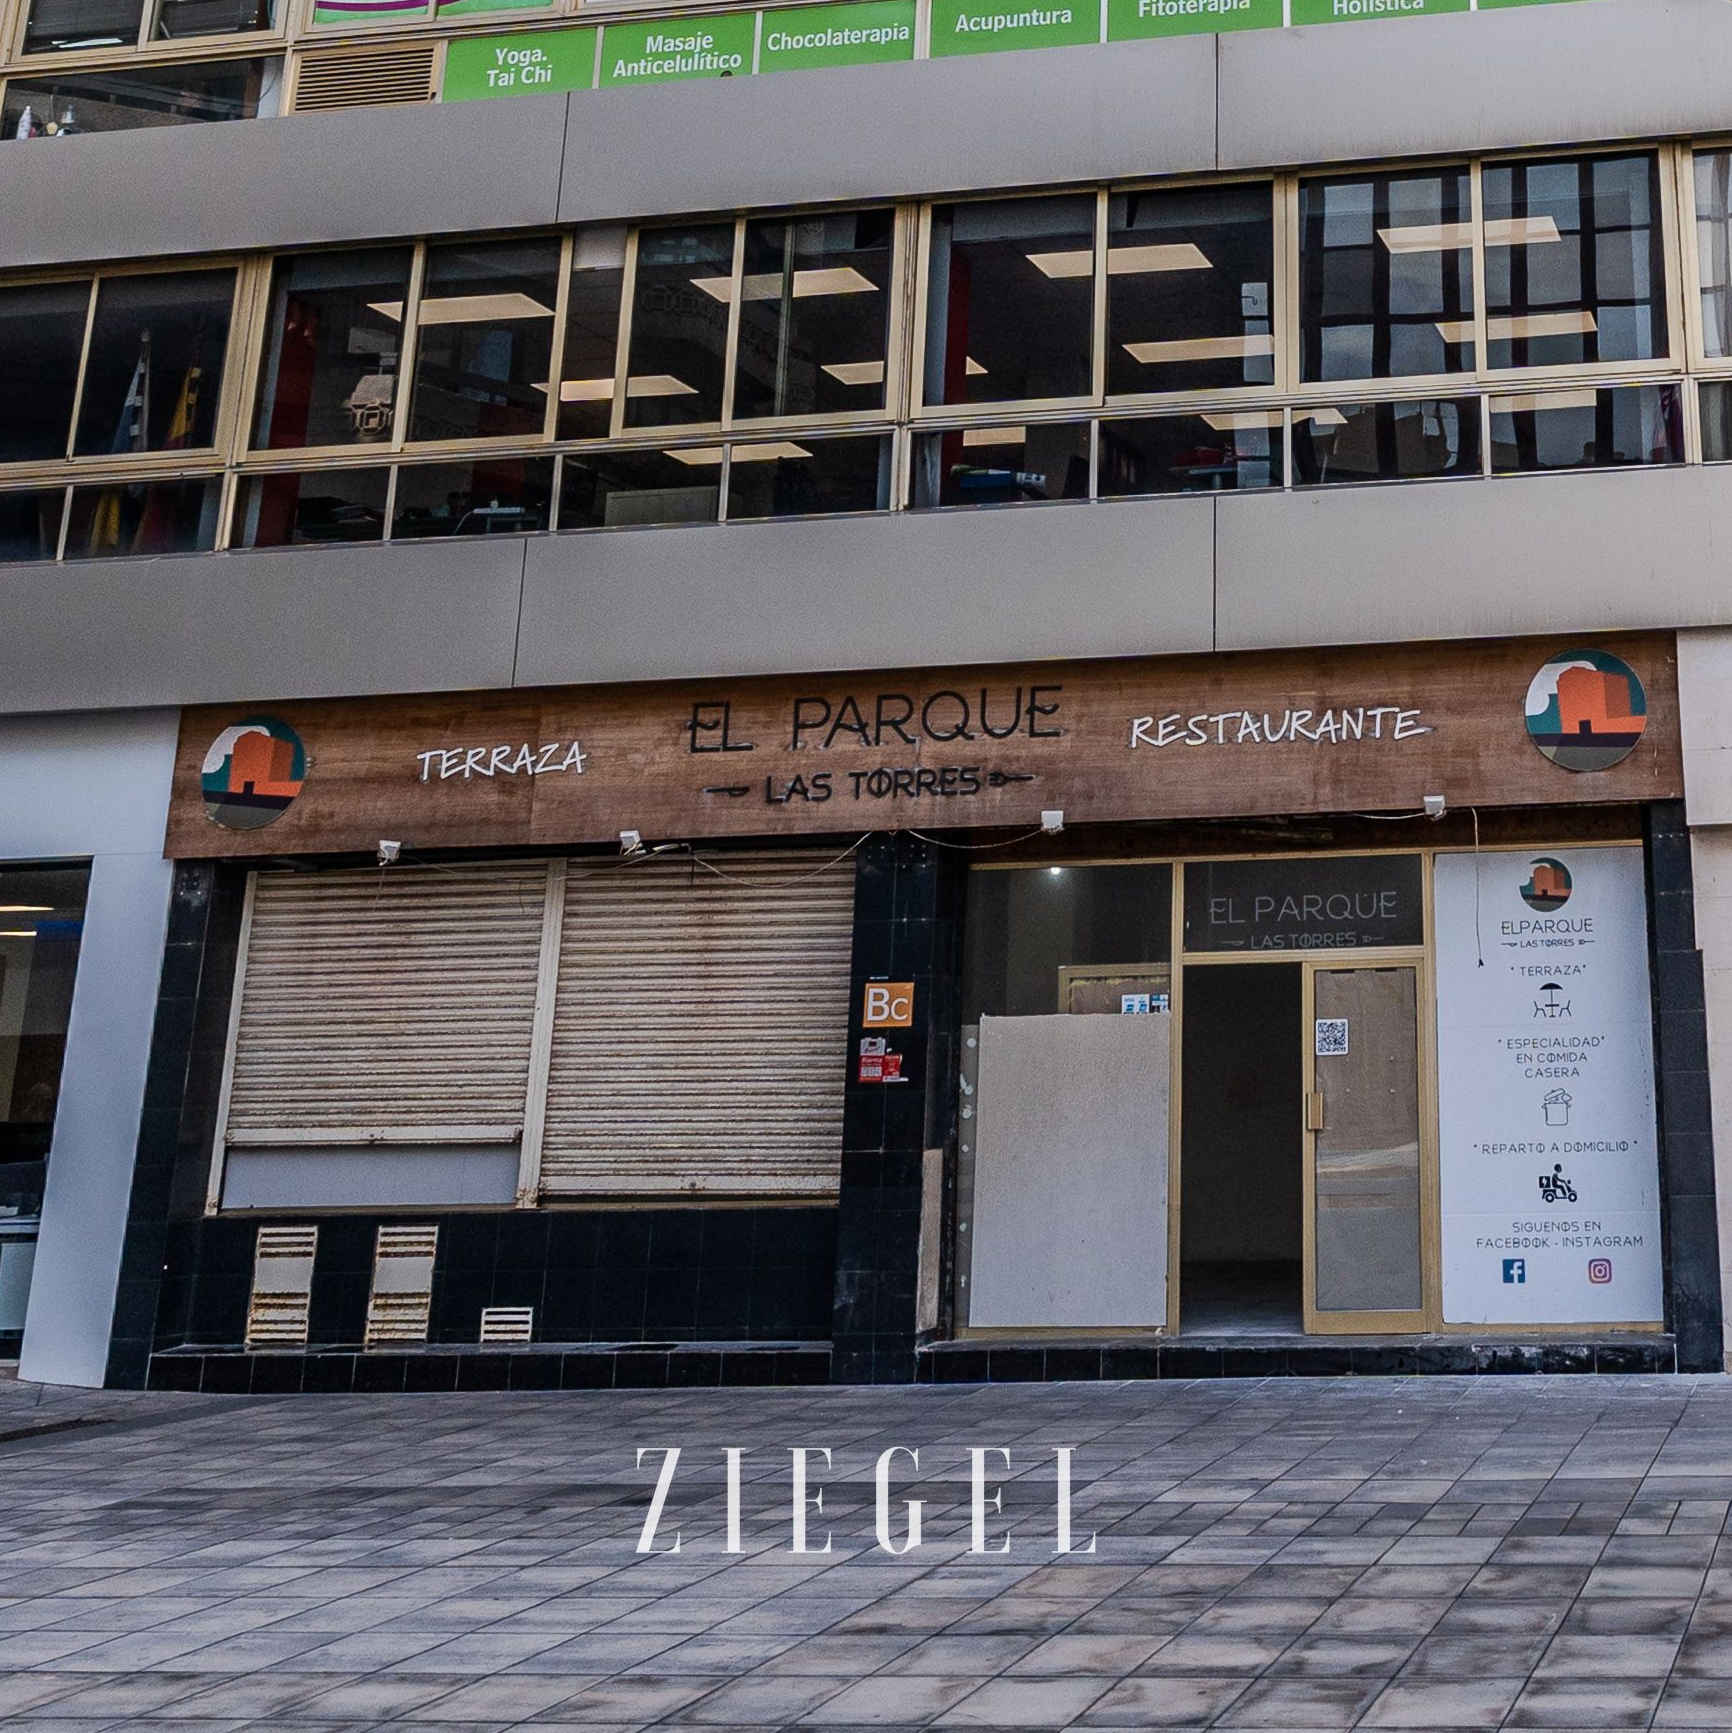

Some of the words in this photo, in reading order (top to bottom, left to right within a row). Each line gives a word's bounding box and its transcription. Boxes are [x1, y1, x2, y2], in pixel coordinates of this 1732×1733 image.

[955, 6, 1072, 34] Acupuntura
[646, 31, 714, 57] Masaje
[767, 24, 910, 54] Chocolaterapia
[495, 46, 548, 67] Yoga.
[612, 51, 742, 78] Anticelulítico
[486, 66, 517, 87] Tai
[521, 64, 553, 85] Chi
[686, 700, 755, 754] EL
[790, 684, 1064, 751] PARQUE
[1130, 706, 1427, 749] RESTAURANTE
[417, 741, 587, 782] TERRAZA
[765, 771, 834, 804] LAS
[848, 766, 982, 801] TORRES
[1209, 898, 1246, 924] EL
[1254, 892, 1397, 923] PARQUE
[1251, 934, 1285, 949] LAS
[1285, 932, 1357, 948] TORRES
[1520, 940, 1538, 949] LAS
[1539, 938, 1575, 948] TORRES
[1520, 965, 1582, 976] TERRAZA
[867, 987, 909, 1021] Bc
[1507, 1036, 1601, 1050] ESPECIALIDAD
[1516, 1053, 1533, 1064] EN
[1536, 1052, 1588, 1063] COMIDA
[1524, 1067, 1581, 1079] CASERA
[1482, 1143, 1546, 1155] REPARTO
[1550, 1142, 1560, 1153] A
[1563, 1141, 1629, 1153] DOMICILIO
[1512, 1221, 1580, 1233] SIGUENOS
[1584, 1221, 1601, 1231] EN
[1476, 1236, 1550, 1249] FACEBOOK
[1562, 1235, 1643, 1248] INSTAGRAM
